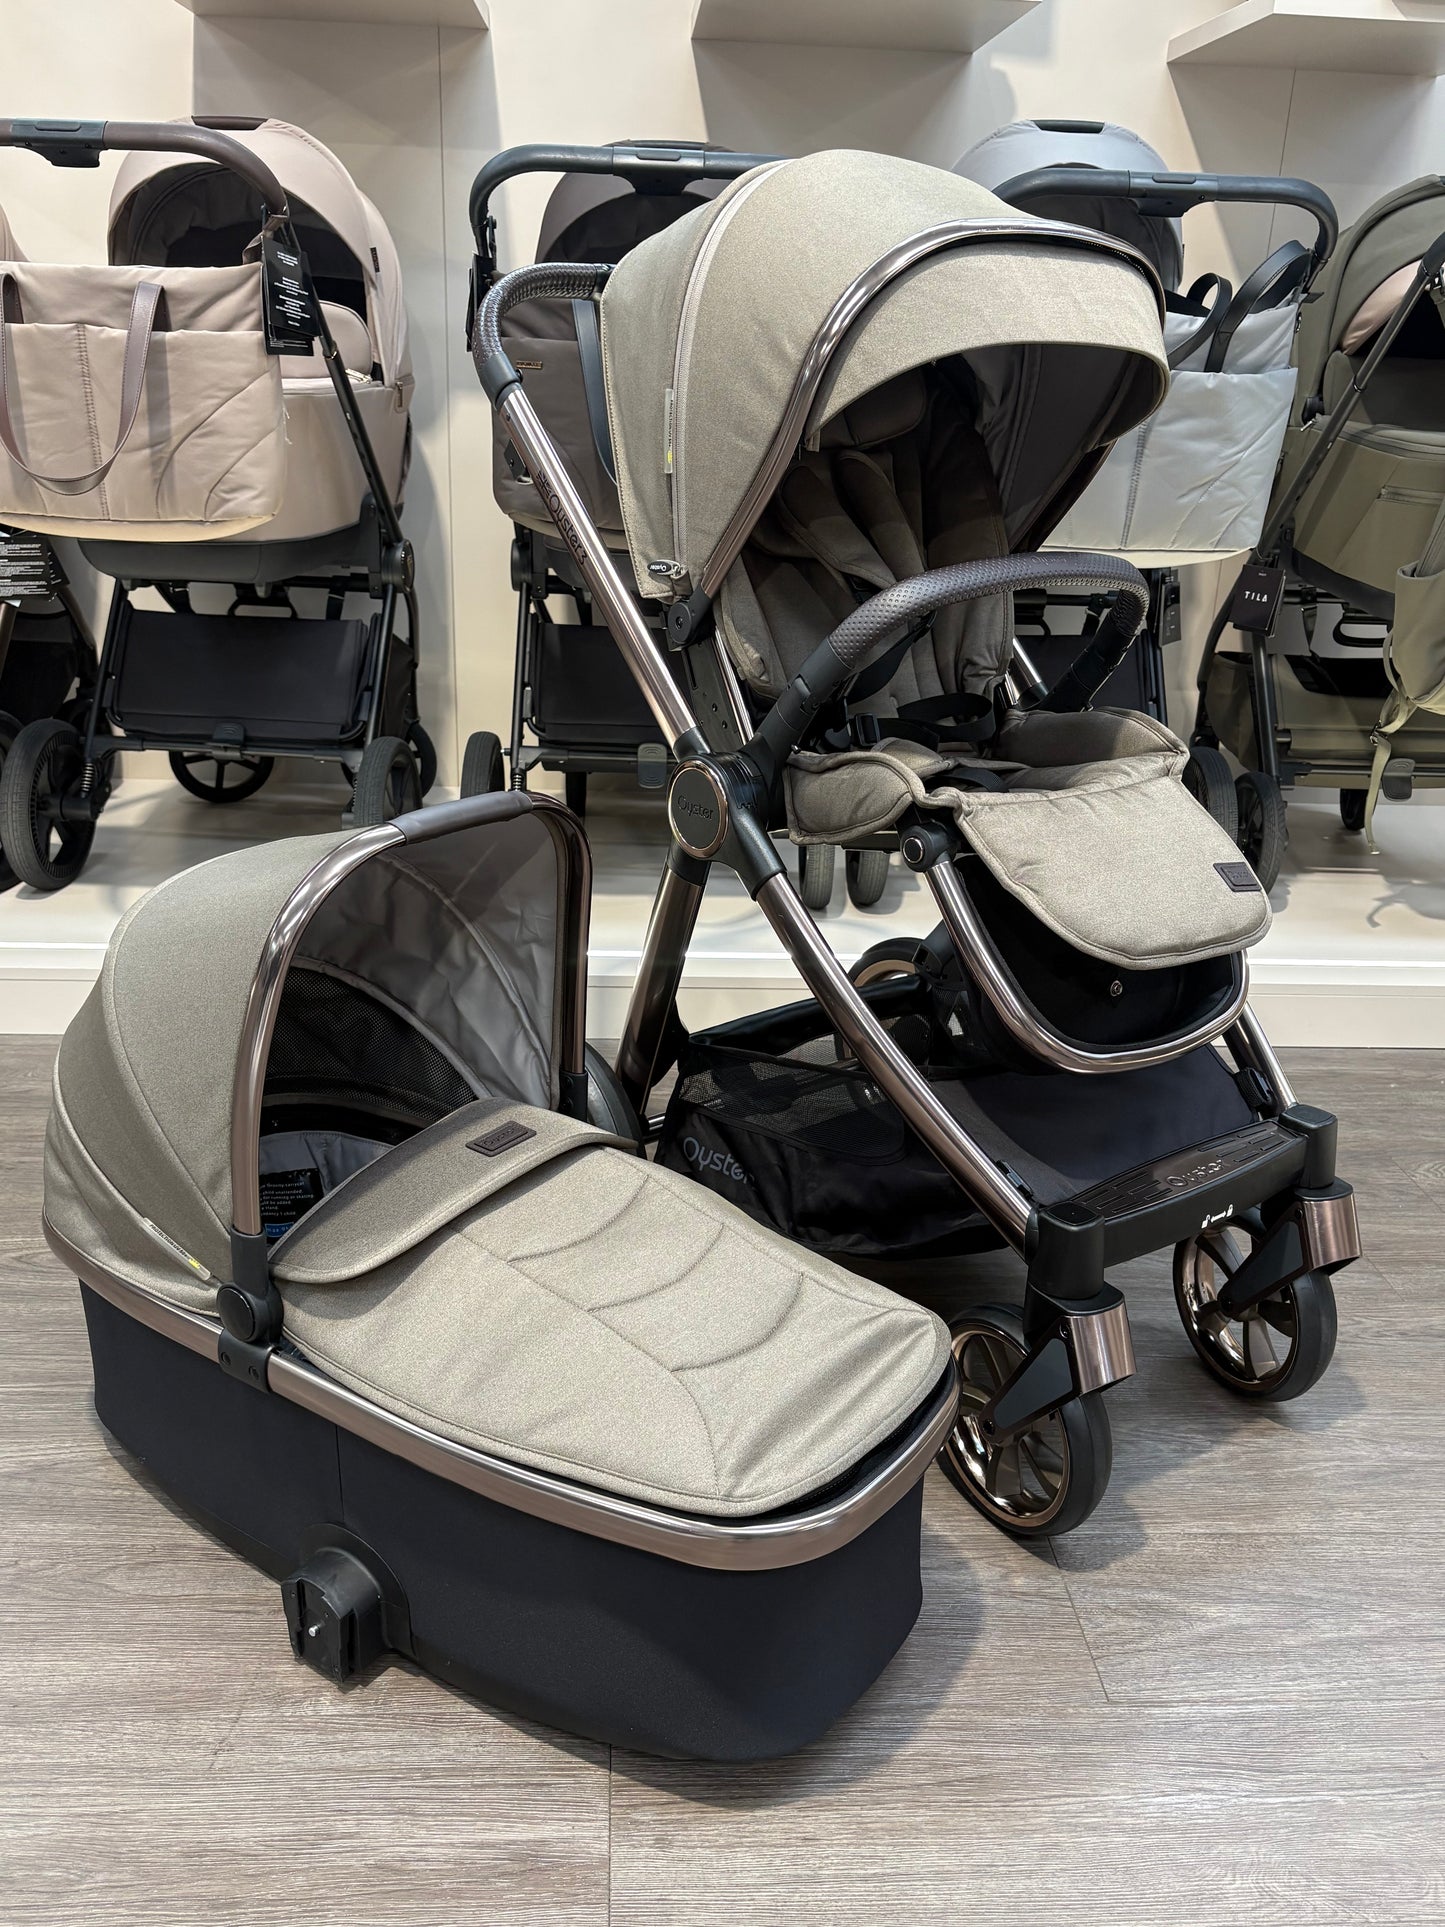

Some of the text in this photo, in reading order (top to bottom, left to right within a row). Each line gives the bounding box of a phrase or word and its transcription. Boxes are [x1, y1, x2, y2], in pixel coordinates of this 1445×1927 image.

[1244, 590, 1268, 602] TILA
[677, 795, 714, 820] Oyster
[1166, 1159, 1222, 1188] Oyster
